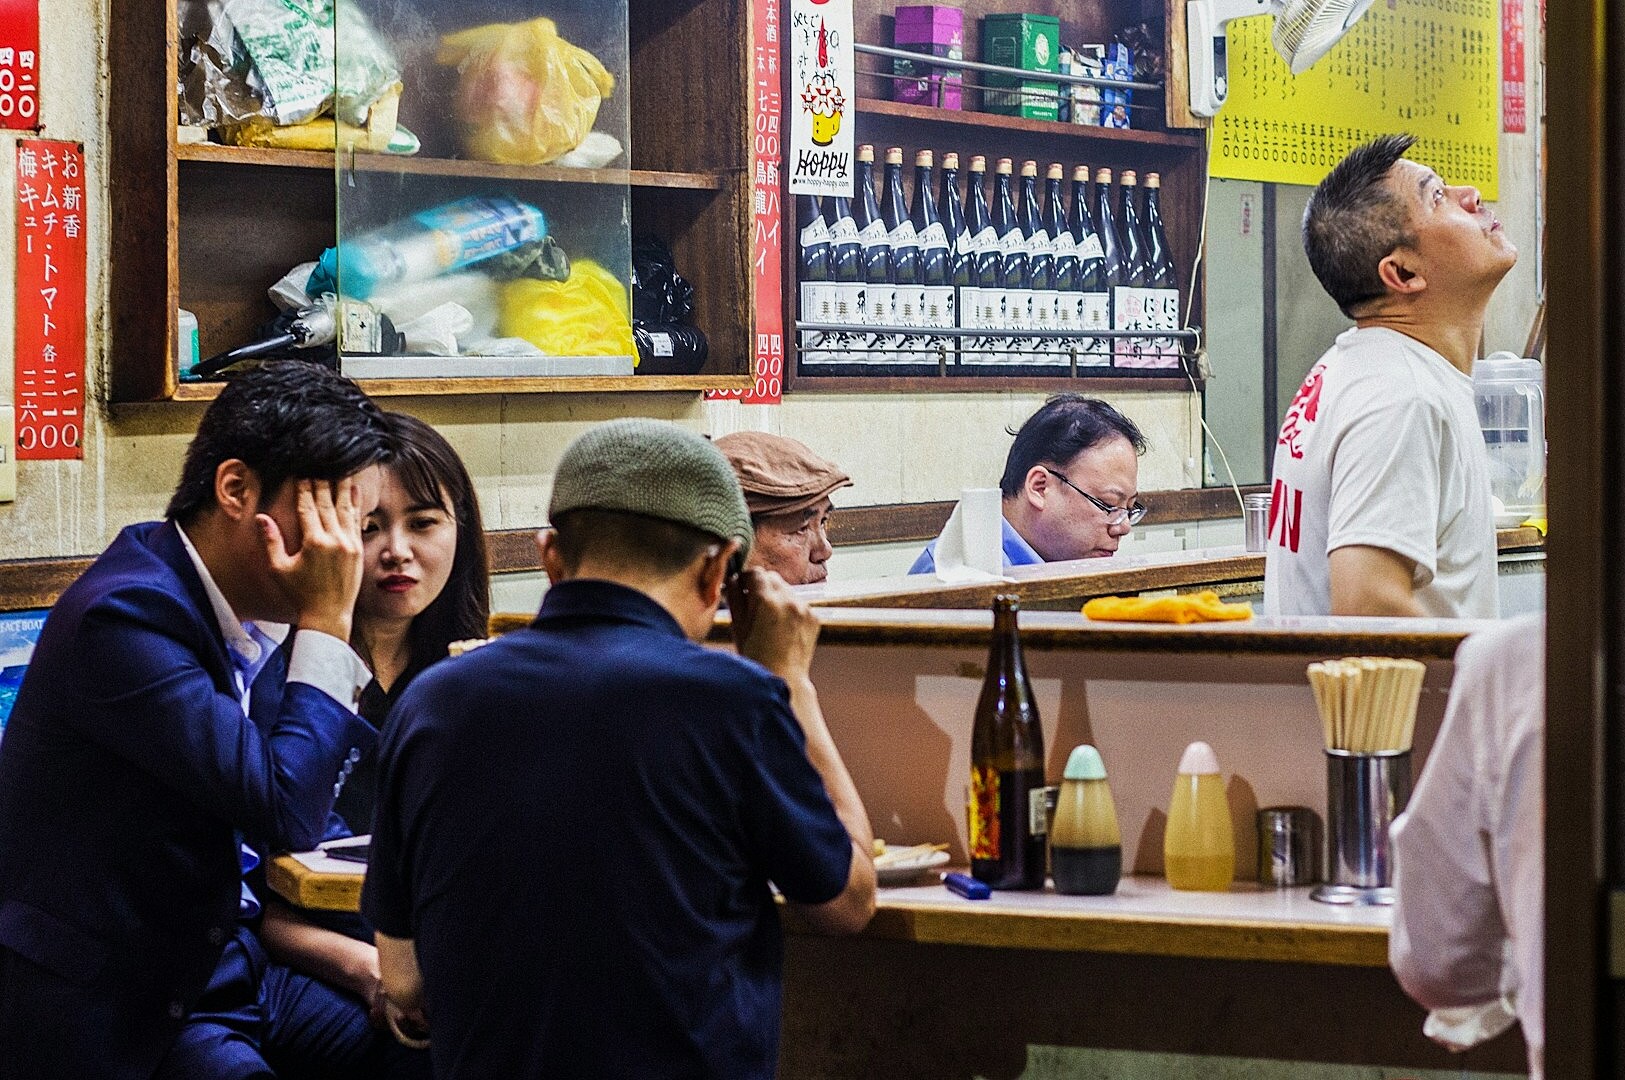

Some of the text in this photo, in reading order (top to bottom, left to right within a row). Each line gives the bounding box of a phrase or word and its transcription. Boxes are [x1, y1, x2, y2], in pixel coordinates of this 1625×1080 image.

[766, 0, 776, 42] 本酒
[18, 50, 36, 118] 四二〇
[62, 150, 81, 238] お新香
[795, 149, 848, 177] Hoppy
[18, 148, 39, 253] 梅キュー
[756, 334, 768, 397] 四〇〇
[769, 334, 781, 397] 四〇〇
